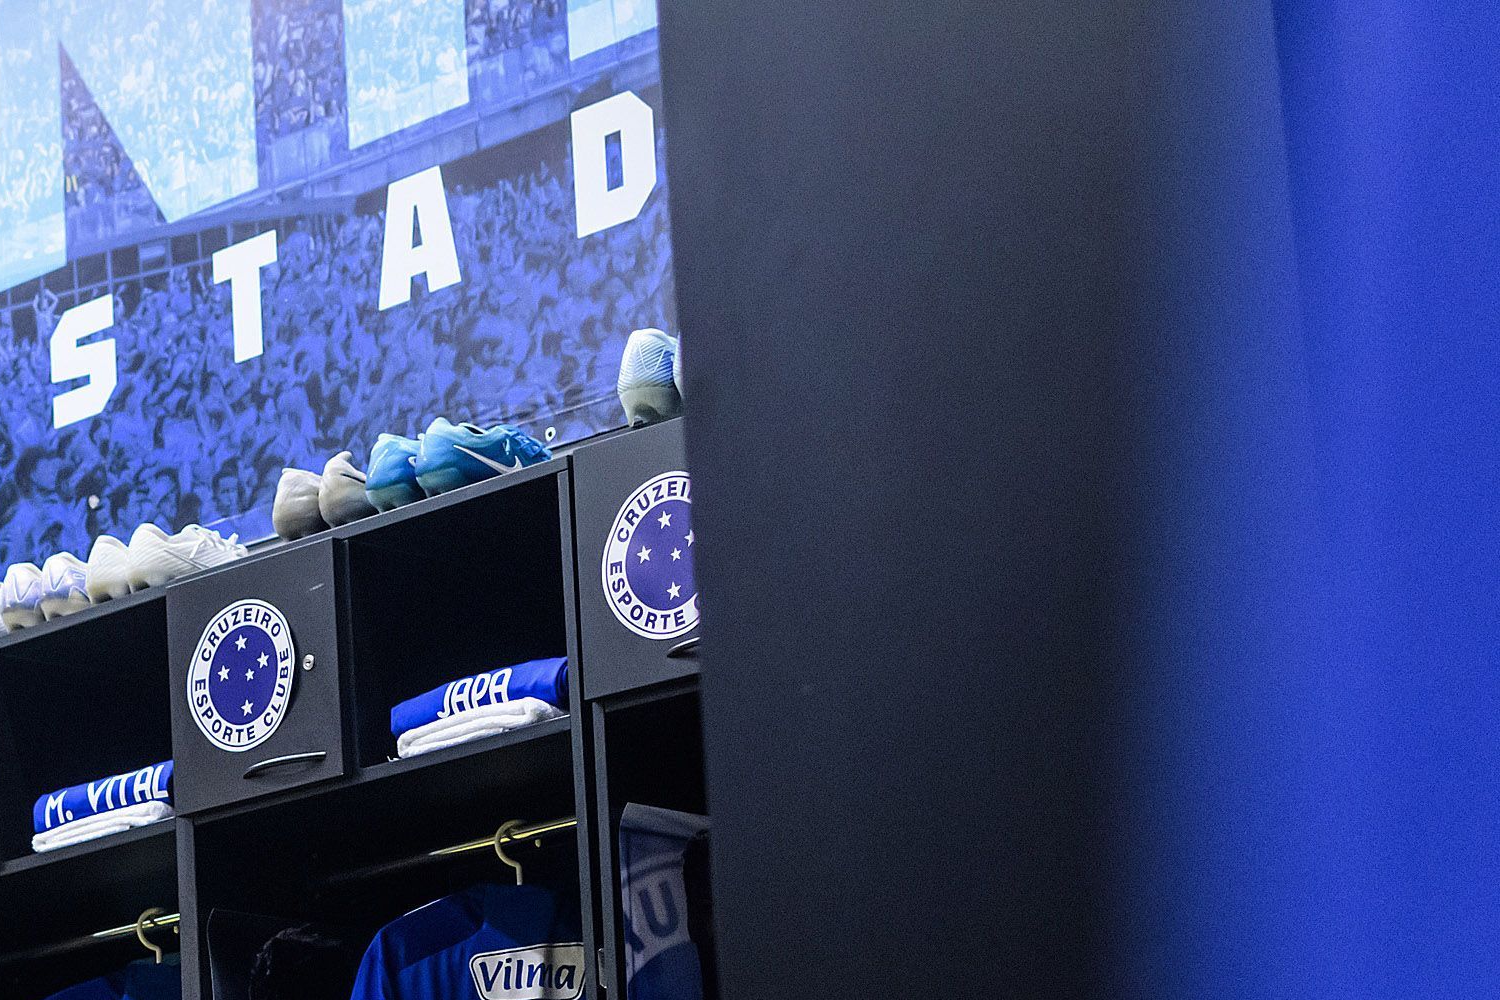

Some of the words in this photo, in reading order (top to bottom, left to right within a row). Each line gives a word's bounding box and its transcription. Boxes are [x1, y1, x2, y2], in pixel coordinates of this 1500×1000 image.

[617, 481, 692, 543] CRUZEI
[610, 561, 686, 630] ESPORTE
[201, 608, 281, 663] CRUZEIRO
[195, 679, 256, 743] ESPORTE
[264, 648, 290, 728] CLUBE
[437, 668, 512, 719] JAPA
[44, 791, 73, 828] M.
[87, 764, 169, 813] VITAL
[479, 958, 577, 993] Vilma
